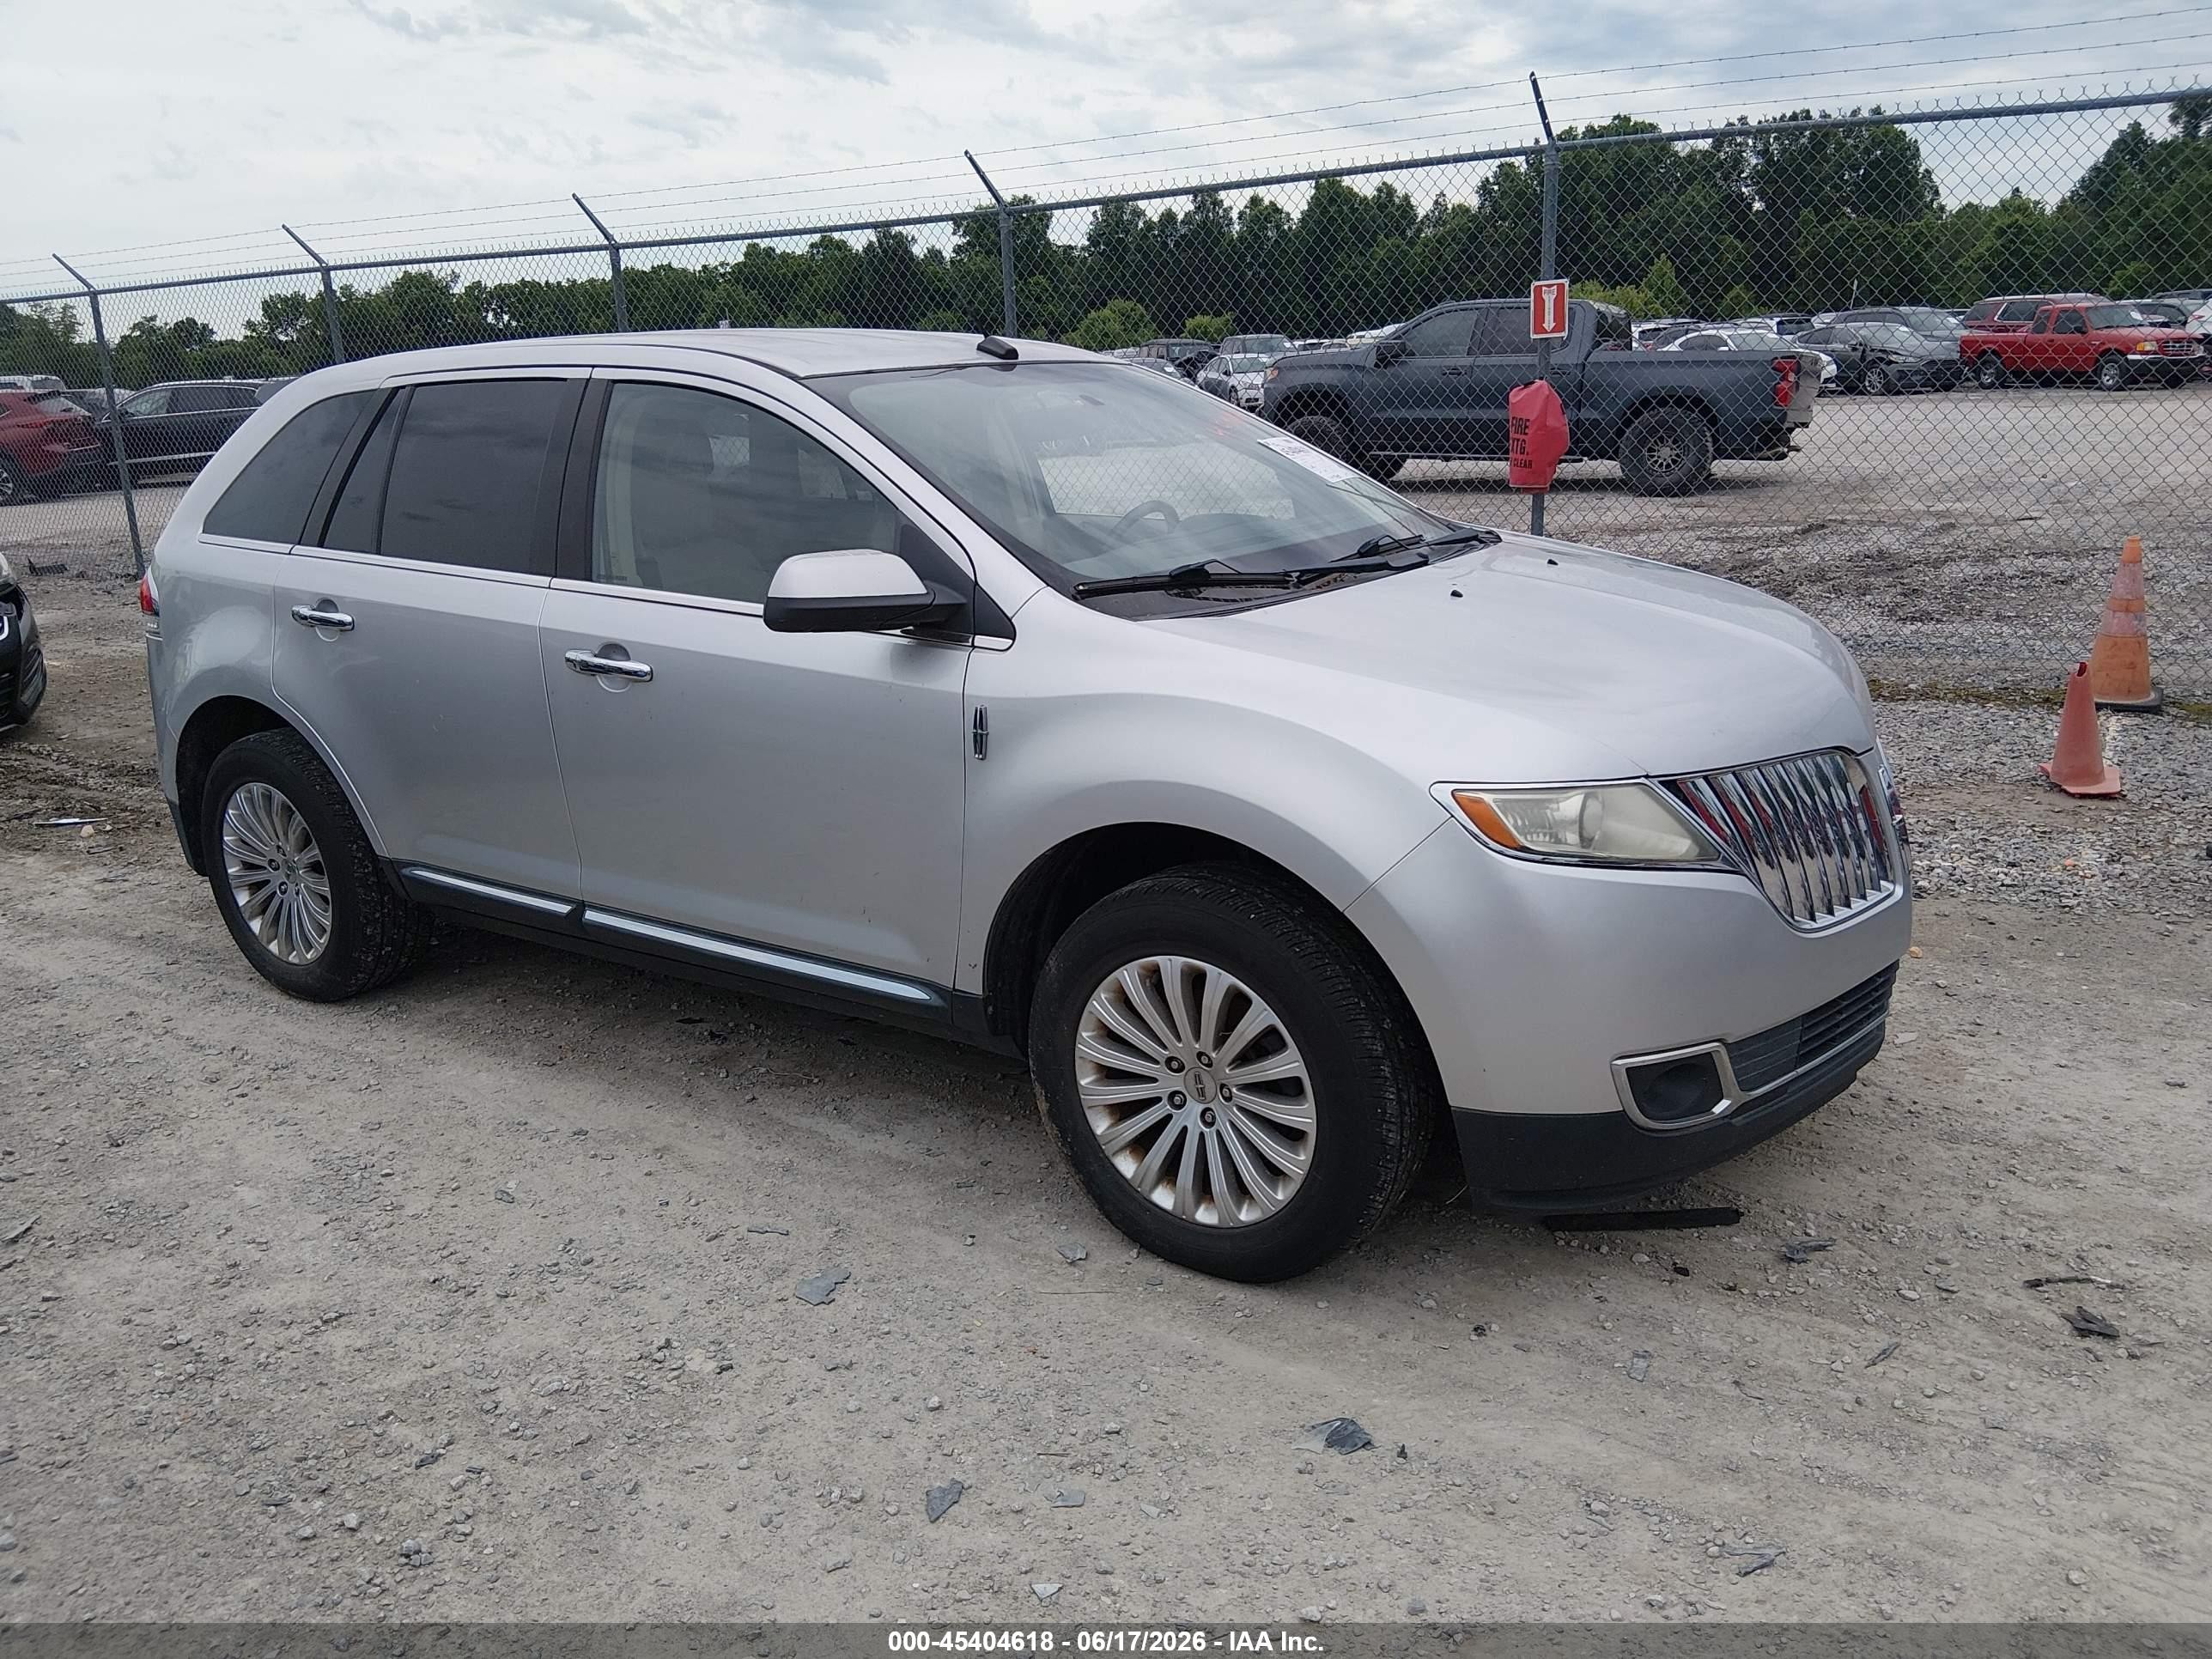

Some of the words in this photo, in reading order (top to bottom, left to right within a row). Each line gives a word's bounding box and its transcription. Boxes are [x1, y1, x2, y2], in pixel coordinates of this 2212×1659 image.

[1510, 416, 1530, 435] FIRE
[1510, 437, 1529, 455] XTG.
[1513, 457, 1533, 470] CLEAR
